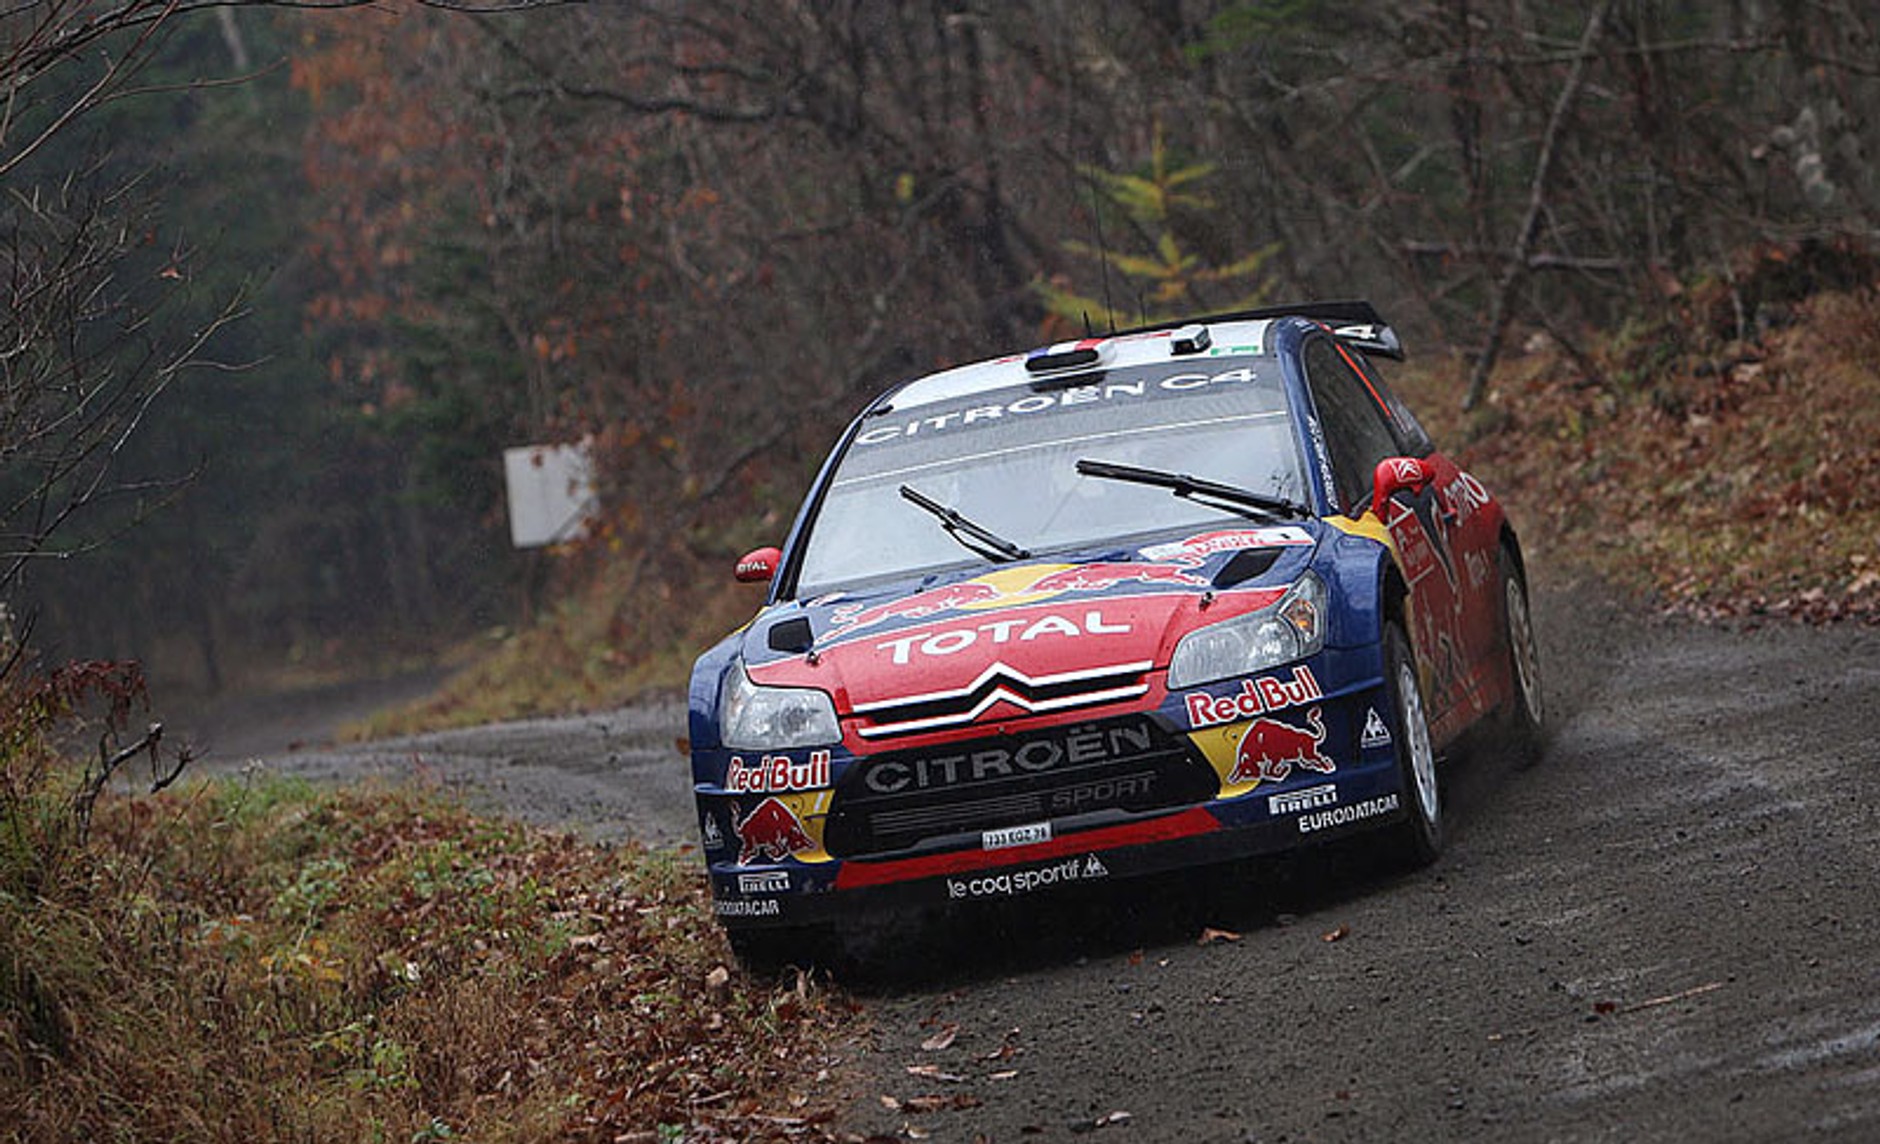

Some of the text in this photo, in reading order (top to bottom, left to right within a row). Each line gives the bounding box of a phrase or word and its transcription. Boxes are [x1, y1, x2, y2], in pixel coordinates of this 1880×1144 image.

[856, 367, 1258, 444] CITROËN C4
[736, 560, 769, 574] OTAL
[877, 611, 1131, 663] TOTAL
[1185, 664, 1323, 728] Red Bull
[724, 750, 830, 792] Red Bull
[864, 723, 1150, 792] CITROËN
[1052, 775, 1157, 808] SPORT
[1269, 784, 1337, 815] PIRELLI
[738, 871, 791, 893] PIRELLI
[947, 858, 1079, 898] le coq sportif
